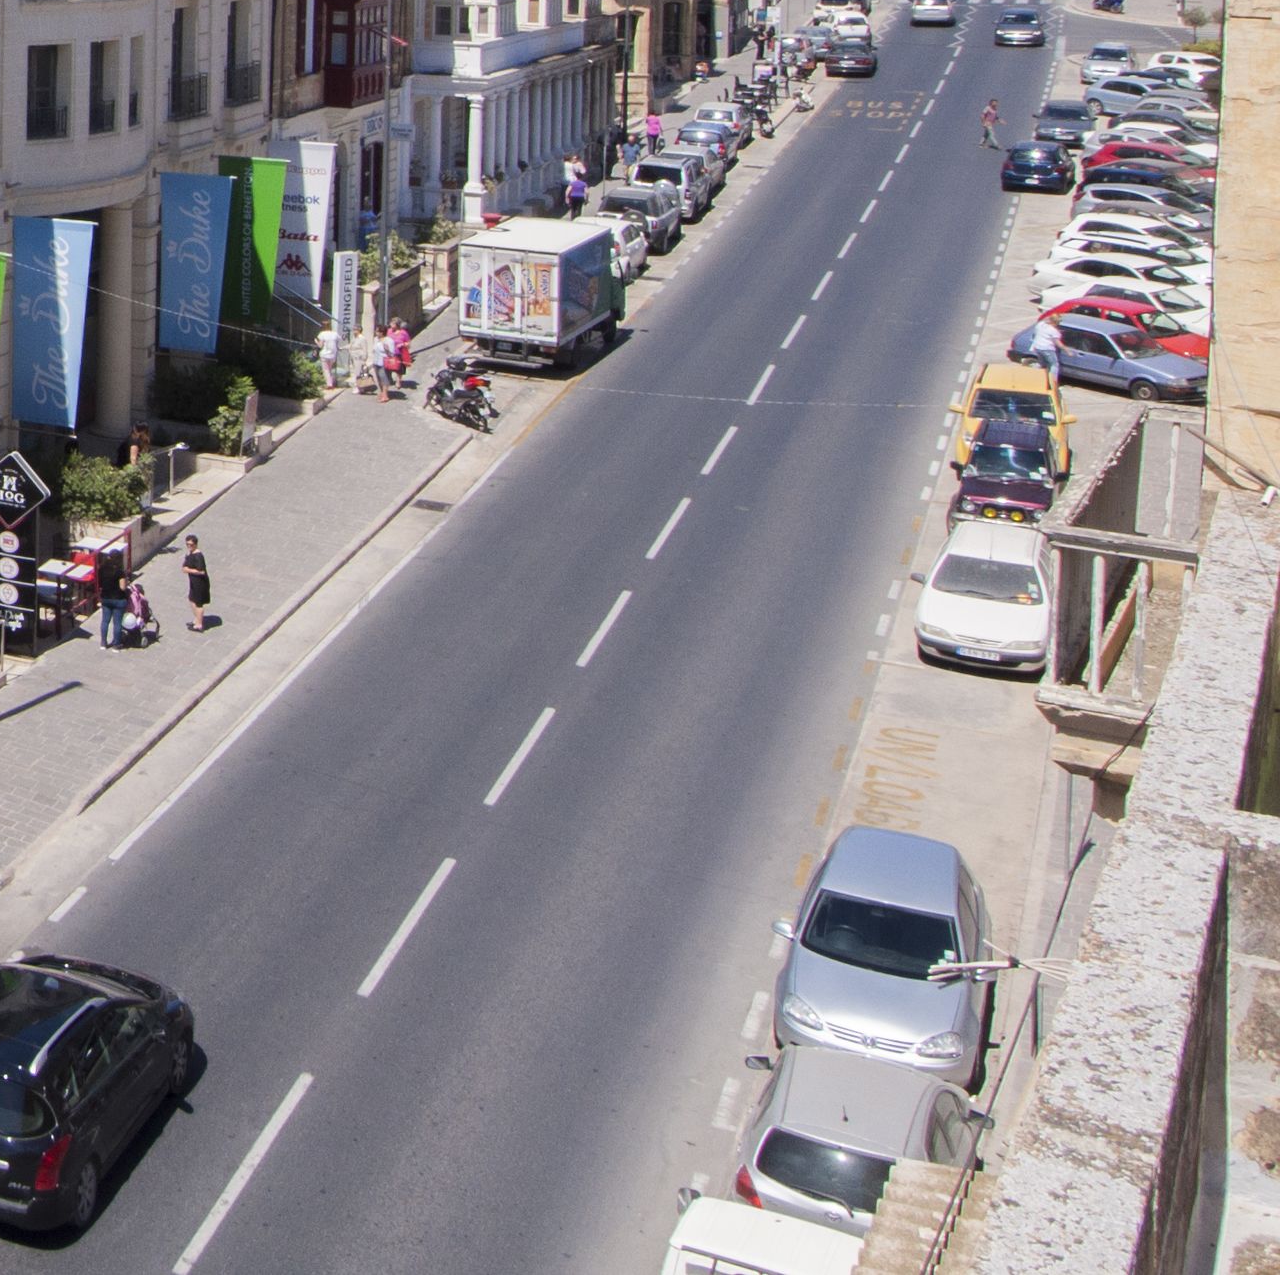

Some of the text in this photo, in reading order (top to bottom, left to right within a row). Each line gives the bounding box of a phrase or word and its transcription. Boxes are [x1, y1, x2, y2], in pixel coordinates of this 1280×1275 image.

[846, 100, 904, 109] BUS
[828, 109, 905, 119] STOP
[283, 194, 321, 205] eebok
[281, 203, 308, 213] tness
[242, 221, 252, 236] OF
[177, 188, 212, 338] The Duke
[241, 236, 252, 277] COLORS
[342, 258, 353, 342] SPRINGFIELD
[31, 236, 70, 410] The Duke
